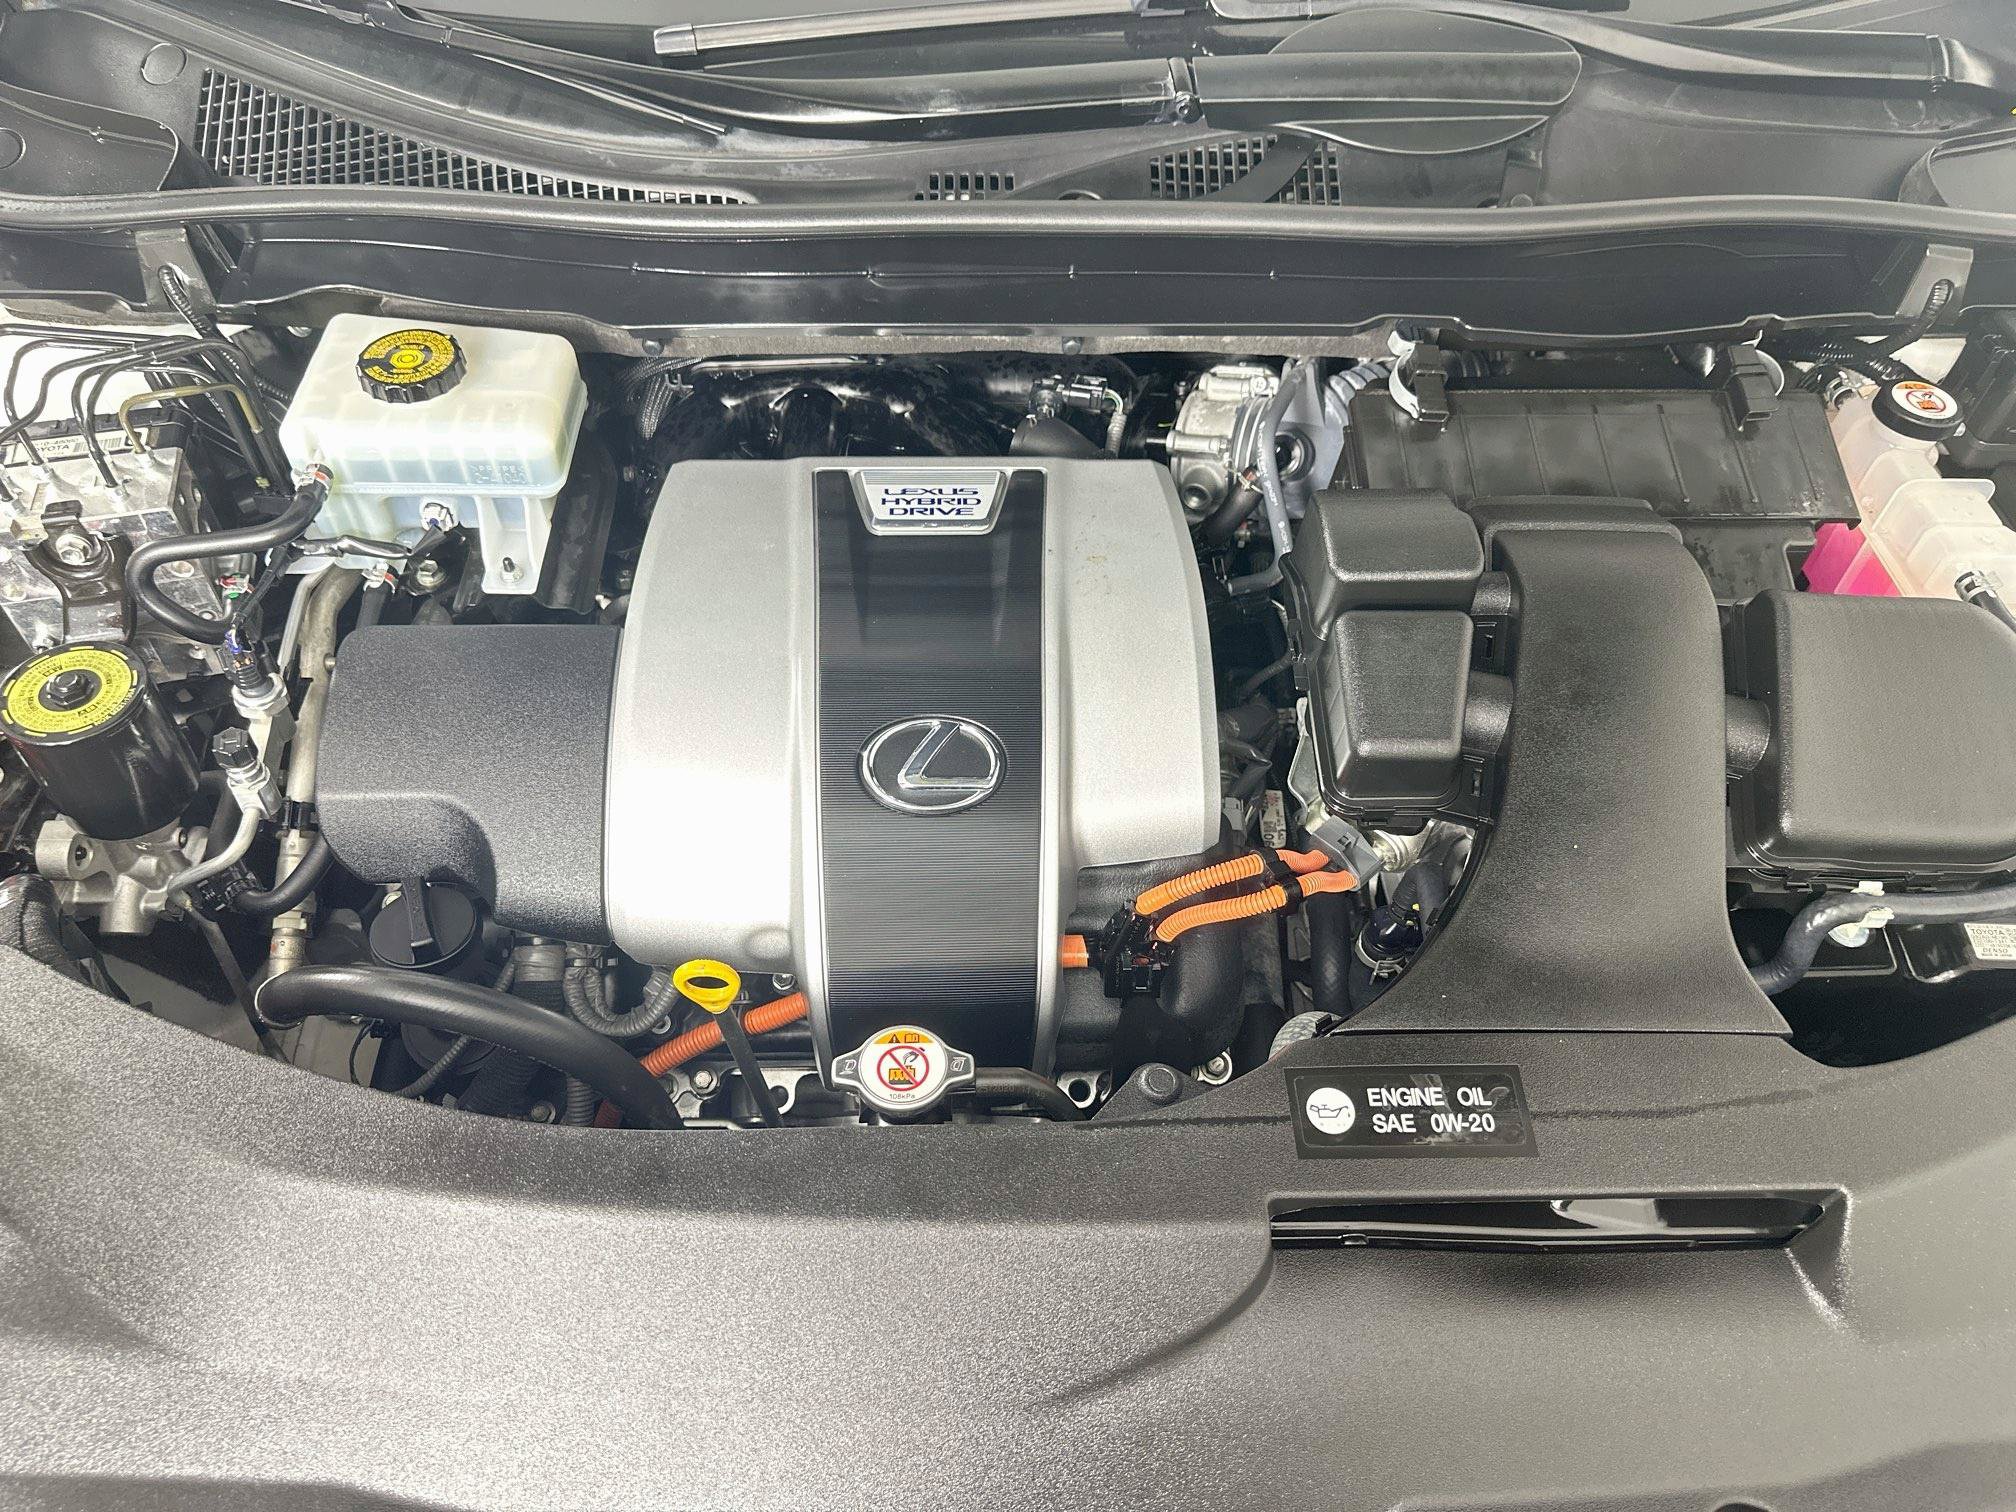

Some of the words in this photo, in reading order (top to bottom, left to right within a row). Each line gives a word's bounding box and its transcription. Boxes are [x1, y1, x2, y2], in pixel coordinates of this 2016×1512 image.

[884, 487, 979, 496] LEXUS
[881, 497, 982, 506] HYBRID
[889, 507, 974, 516] DRIVE
[1366, 1087, 1445, 1107] ENGINE
[1456, 1087, 1493, 1107] OIL
[1372, 1113, 1417, 1133] SAE
[1430, 1113, 1495, 1133] 0W-20
